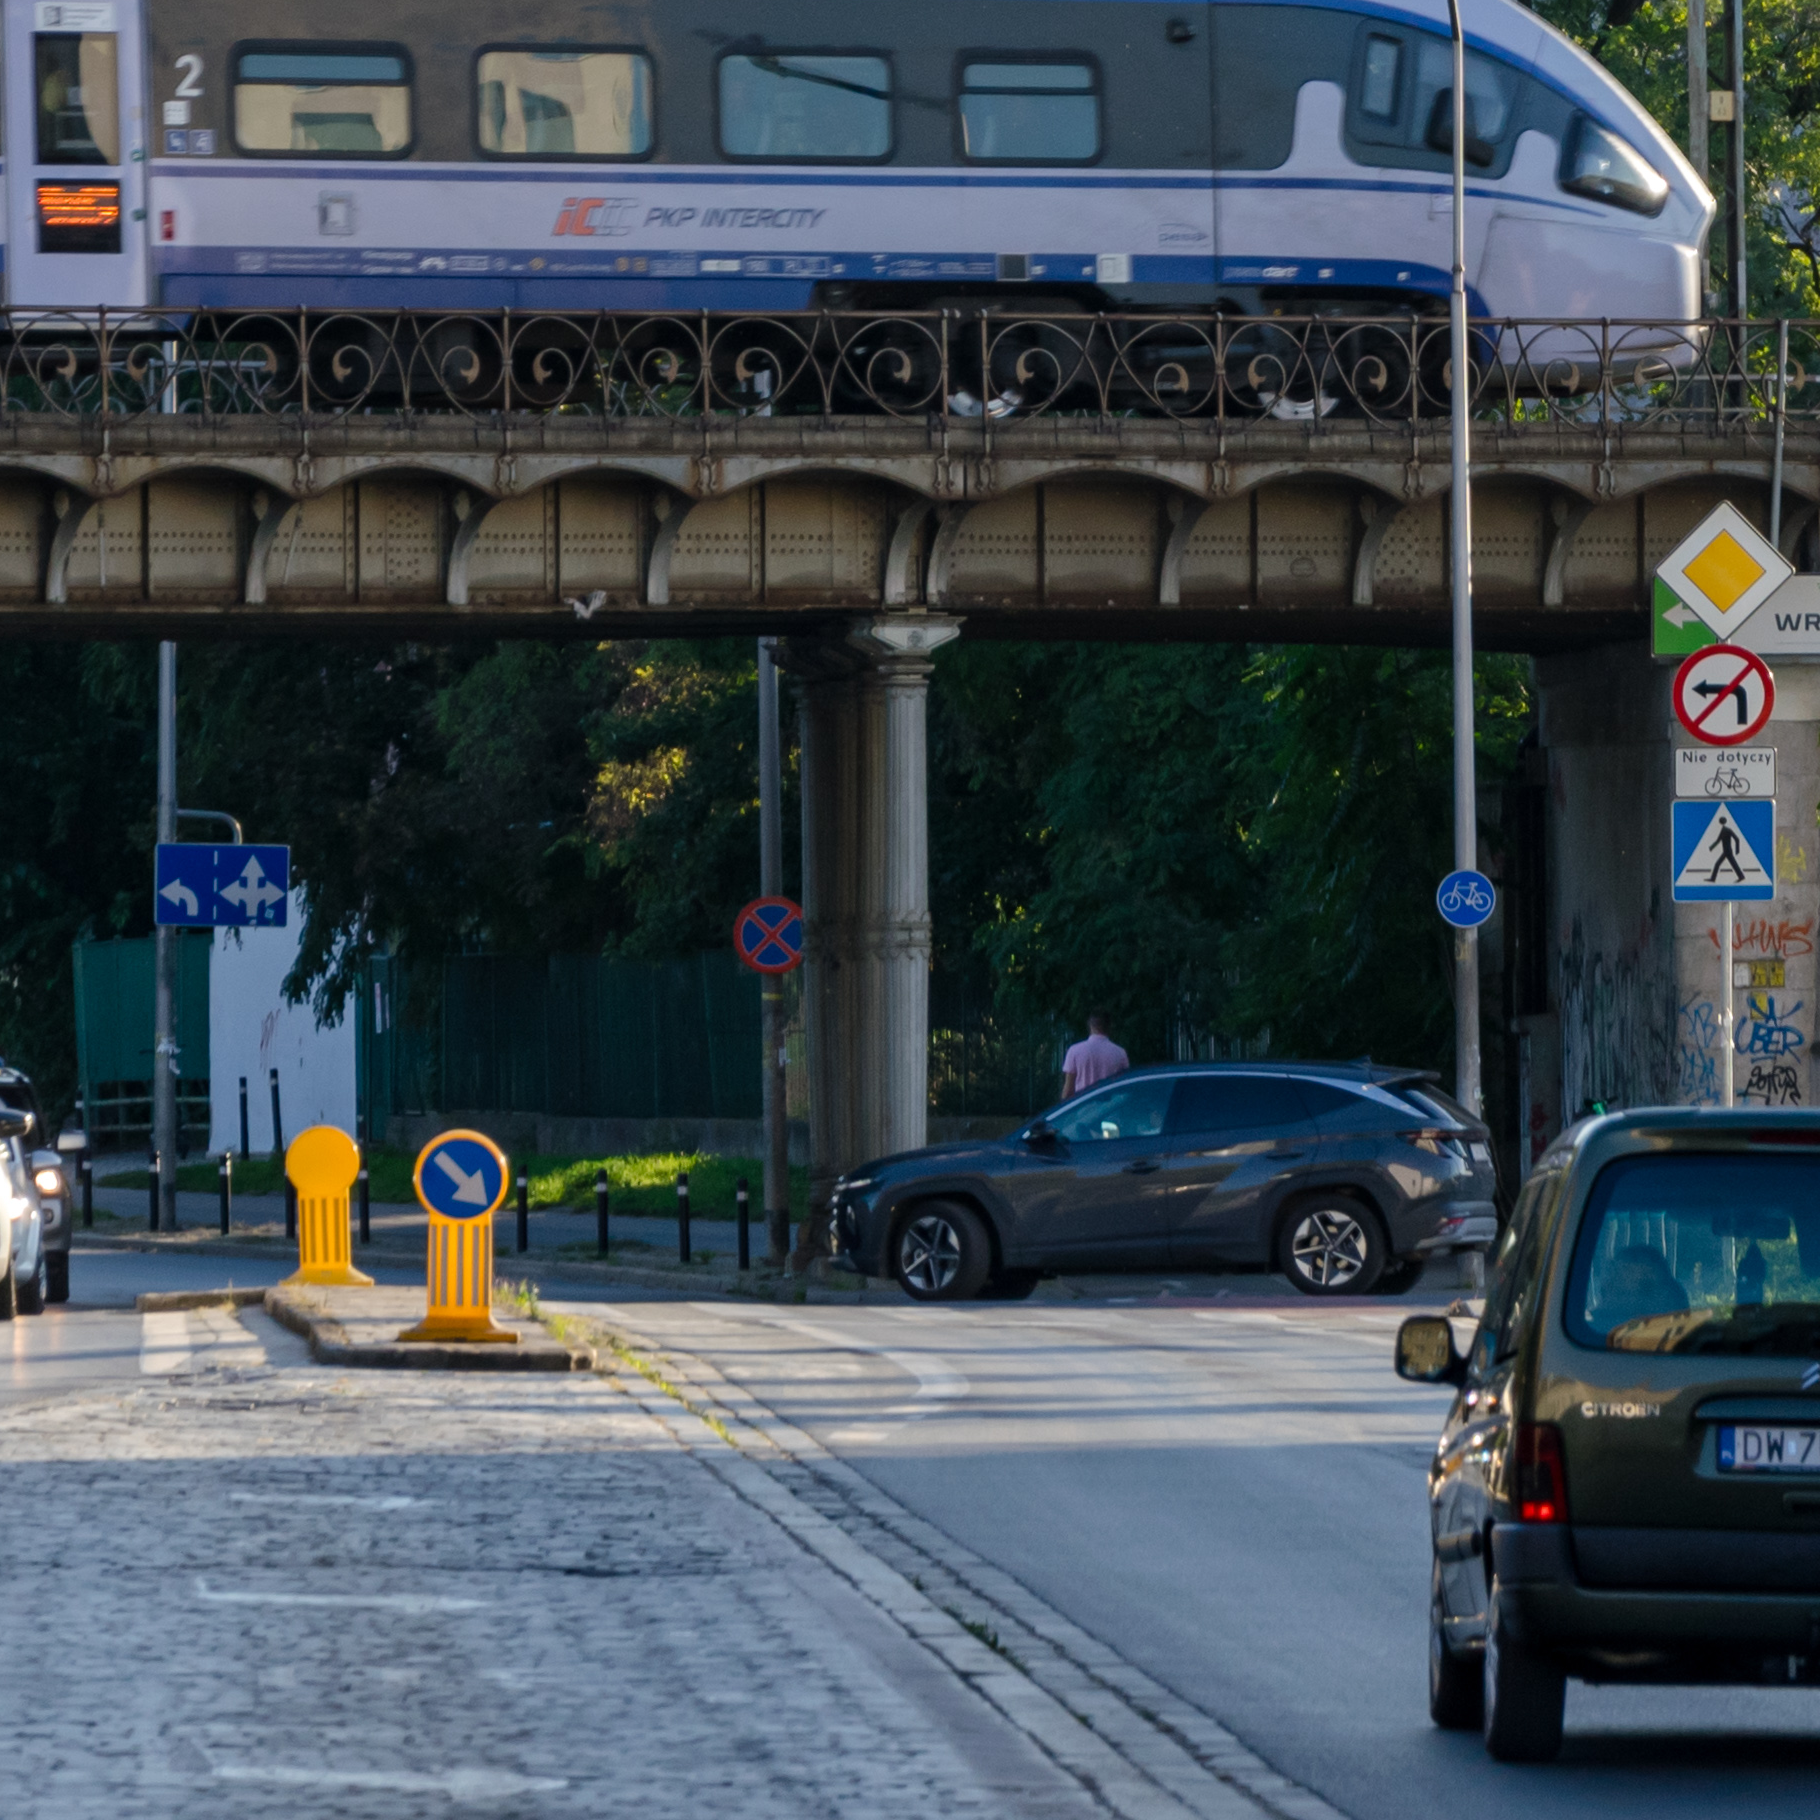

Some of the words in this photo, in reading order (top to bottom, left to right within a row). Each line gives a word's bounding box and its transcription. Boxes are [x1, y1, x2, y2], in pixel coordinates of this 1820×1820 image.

[174, 53, 204, 98] 2
[643, 207, 698, 229] PKP
[700, 208, 826, 229] INTERCITY
[1682, 751, 1707, 763] Nie
[1717, 751, 1772, 766] dotyczy
[1742, 1430, 1786, 1464] DW
